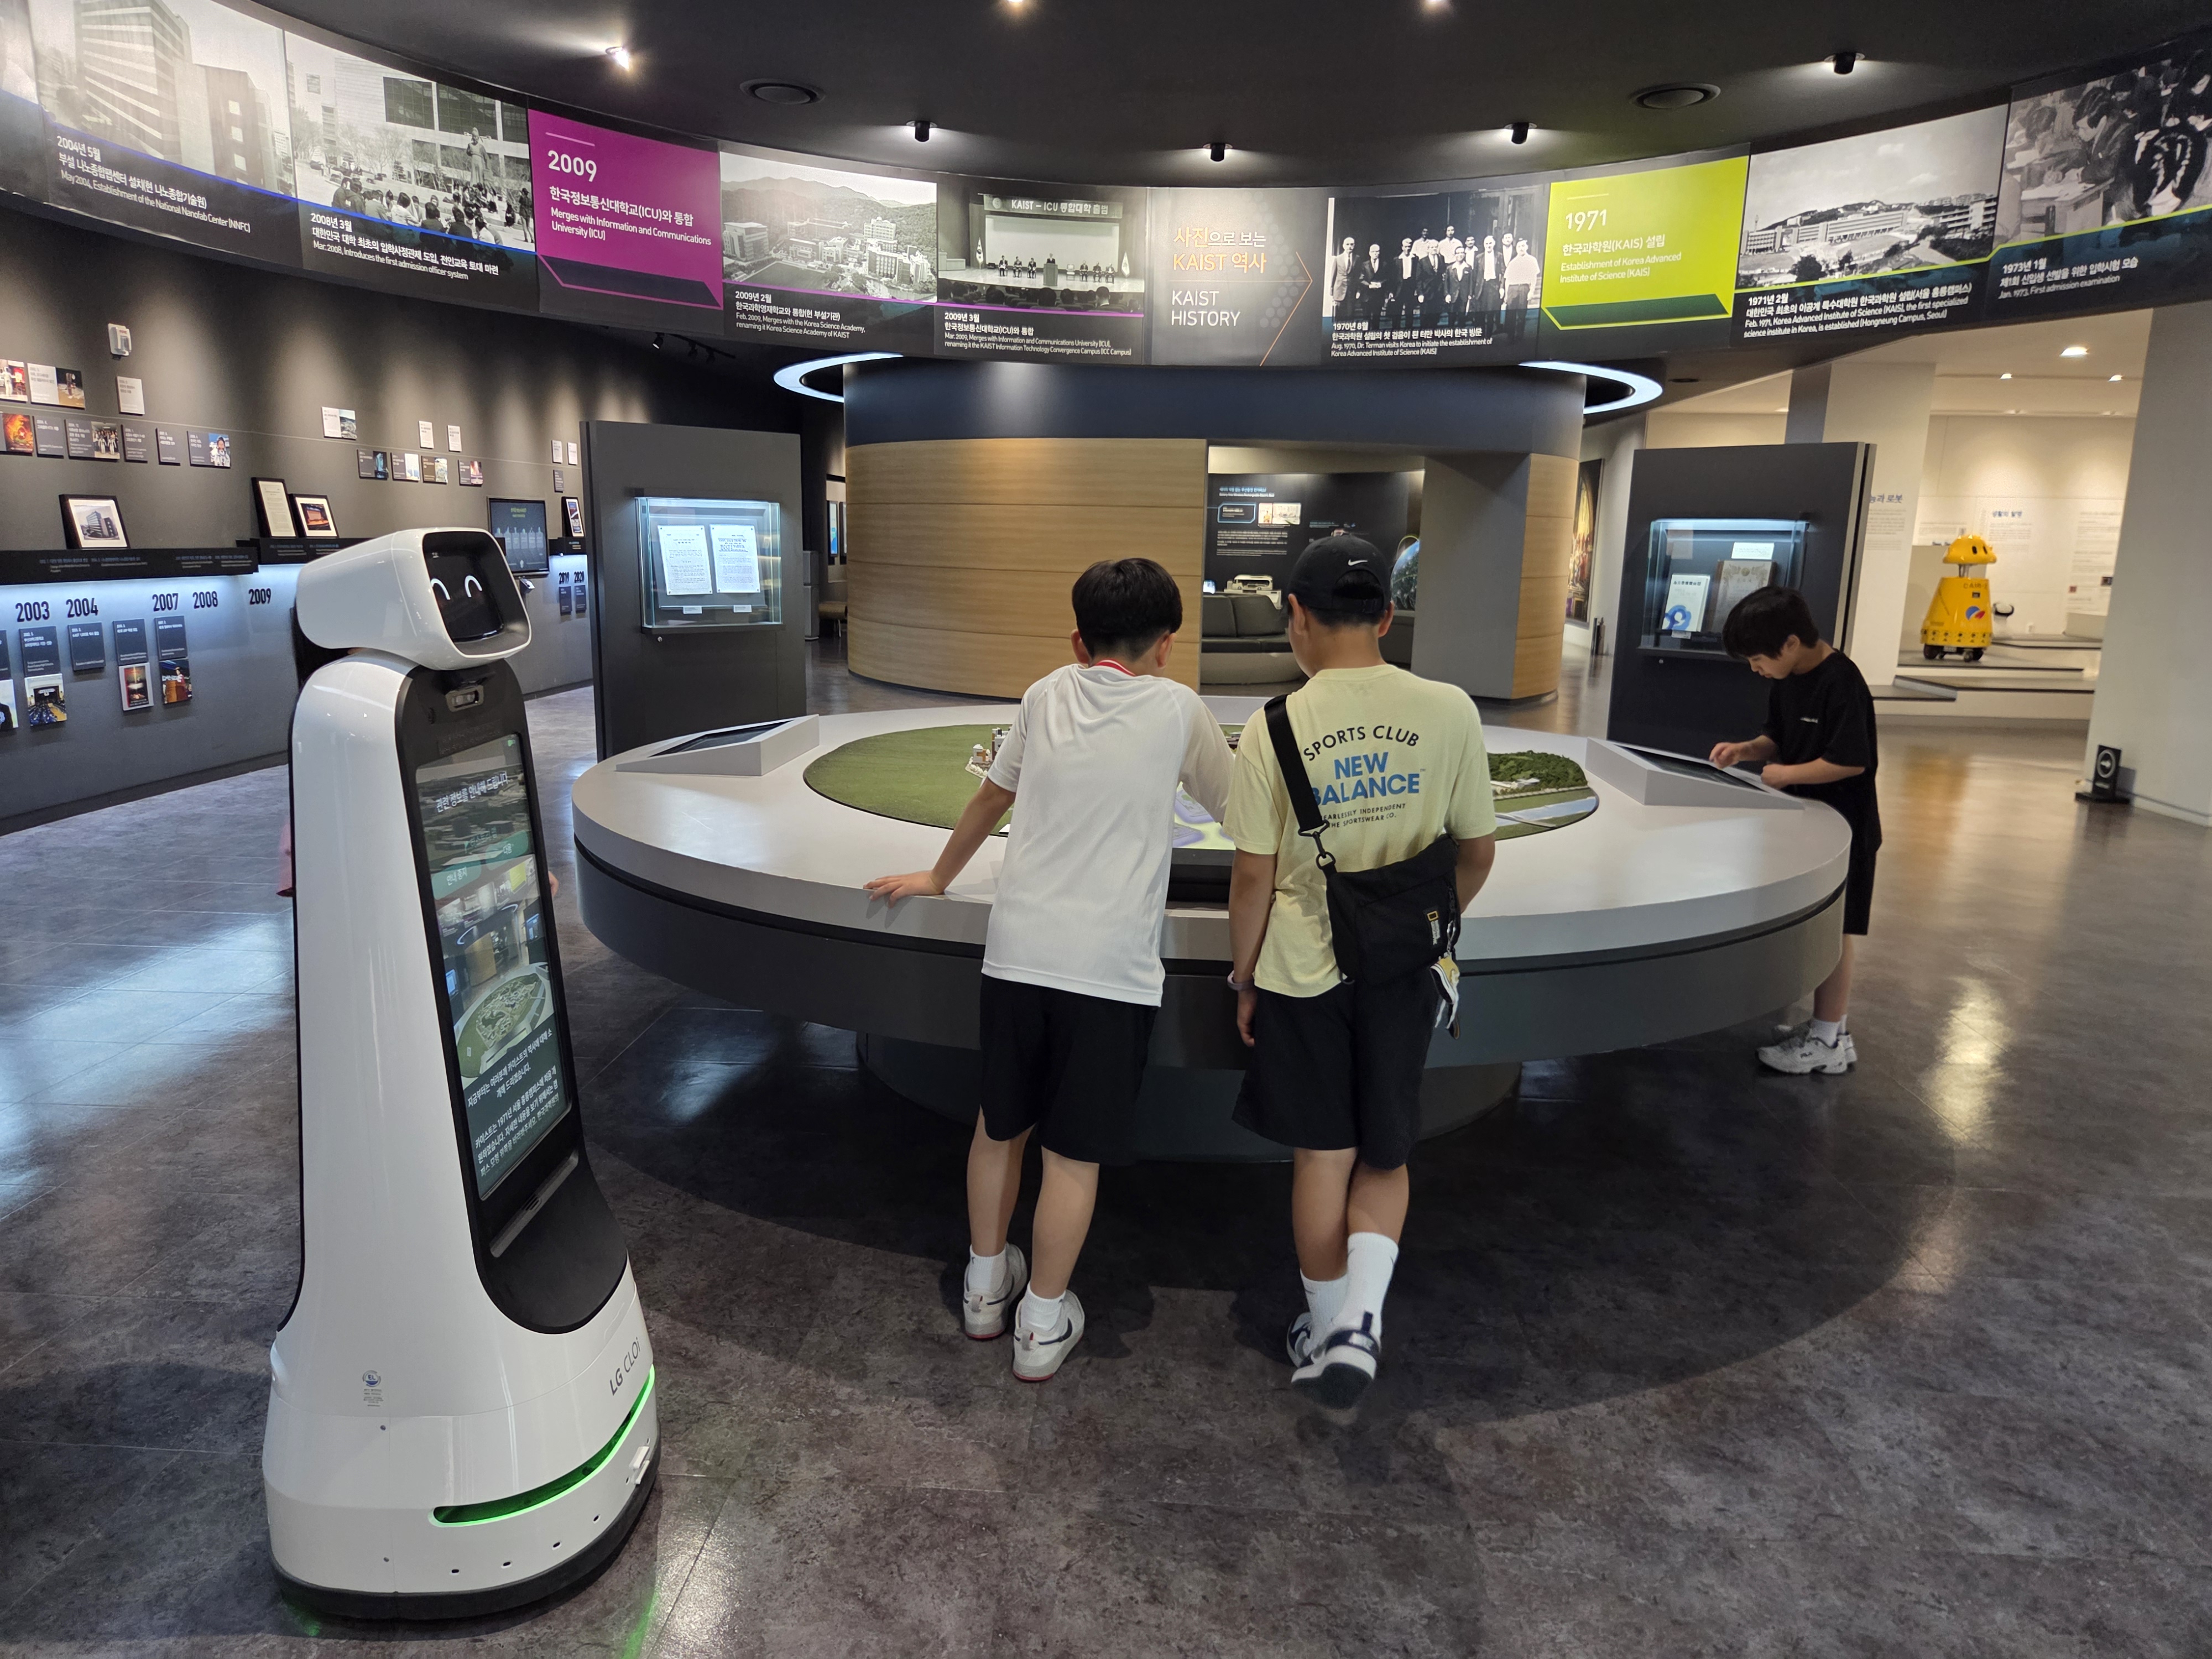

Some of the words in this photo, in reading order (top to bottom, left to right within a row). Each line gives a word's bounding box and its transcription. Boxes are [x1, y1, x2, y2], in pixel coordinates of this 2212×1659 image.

[57, 135, 87, 156] 2004년
[87, 146, 101, 162] 5월
[547, 150, 597, 182] 2009
[59, 152, 75, 169] 부설
[76, 159, 127, 186] 나노종합팹센터
[154, 184, 207, 210] 나노종합기술원)
[61, 169, 75, 184] May
[92, 179, 138, 202] Establishment
[138, 194, 144, 203] of
[144, 196, 155, 207] the
[155, 199, 181, 214] National
[181, 206, 207, 221] Nanofab
[208, 213, 228, 226] Center
[228, 218, 251, 233] (NNFC)
[549, 186, 672, 223] 한국정보통신대학교(ICU)와
[674, 211, 693, 227] 통합
[1011, 200, 1034, 210] KAIST
[1044, 201, 1058, 212] ICU
[1060, 203, 1091, 214] 통합대학
[310, 213, 338, 229] 2008년
[338, 220, 353, 232] 3월
[551, 207, 578, 222] Merges
[580, 213, 596, 225] with
[596, 216, 638, 233] Information
[638, 225, 652, 236] and
[653, 227, 712, 246] Communications
[1566, 208, 1607, 232] 1971
[551, 221, 588, 238] University
[589, 228, 606, 241] (ICU)
[1173, 226, 1235, 248] 사진으로
[1238, 231, 1266, 247] 보는
[312, 227, 340, 243] 대한민국
[342, 234, 356, 246] 대학
[358, 237, 379, 252] 최초의
[380, 242, 422, 261] 입학사정관제
[423, 252, 439, 264] 도입,
[440, 254, 468, 270] 전인교육
[469, 261, 483, 272] 토대
[484, 264, 499, 275] 마련
[1562, 237, 1643, 257] 한국과학원(KAIS)
[1646, 234, 1665, 249] 설립
[313, 239, 325, 250] Mar.
[327, 244, 343, 255] 2008,
[344, 247, 375, 262] Introduces
[375, 254, 385, 264] the
[385, 256, 398, 266] first
[398, 260, 428, 273] admission
[428, 265, 447, 275] officer
[447, 270, 469, 280] system
[1173, 253, 1227, 271] KAIST
[1231, 252, 1267, 273] 역사
[1561, 257, 1613, 272] Establishment
[1614, 257, 1621, 267] of
[1621, 255, 1644, 266] Korea
[1645, 252, 1682, 264] Advanced
[2002, 259, 2032, 274] 1973년
[2033, 257, 2047, 270] 1월
[1559, 271, 1589, 284] Institute
[1589, 271, 1597, 281] of
[1598, 269, 1626, 280] Science
[1627, 267, 1650, 279] (KAIS)
[735, 291, 759, 302] 2009년
[760, 294, 771, 304] 2월
[1172, 290, 1219, 306] KAIST
[1748, 294, 1774, 306] 1971년
[1775, 292, 1788, 304] 2월
[735, 301, 791, 316] 한국과학영재학교와
[814, 310, 841, 321] 부설기관)
[944, 312, 968, 322] 2009년
[969, 314, 980, 323] 3월
[1171, 310, 1241, 326] HISTORY
[736, 322, 761, 331] renaming
[766, 324, 782, 332] Korea
[782, 326, 802, 335] Science
[803, 328, 827, 338] Academy
[833, 331, 851, 339] KAIST
[748, 314, 762, 322] 2009,
[763, 315, 782, 325] Merges
[804, 320, 820, 328] Korea
[820, 321, 840, 330] Science
[840, 323, 865, 333] Academy,
[1021, 327, 1034, 336] 통합
[1333, 322, 1356, 331] 1970년
[1357, 321, 1369, 331] 8월
[1332, 332, 1363, 341] 한국과학원
[15, 601, 50, 622] 2003
[66, 598, 98, 618] 2004
[152, 593, 179, 612] 2007
[192, 591, 218, 609] 2008
[248, 588, 272, 605] 2009
[1303, 726, 1366, 761] SPORTS
[1373, 725, 1419, 747] CLUB
[1334, 752, 1389, 780] NEW
[436, 795, 451, 813] 관련
[450, 788, 468, 807] 정보를
[468, 780, 487, 799] 안내해
[1360, 804, 1406, 814] INDEPENDENT
[1343, 815, 1384, 827] SPORTSWEAR
[503, 843, 513, 855] 다음
[446, 873, 457, 886] 안내
[457, 866, 468, 880] 중지
[468, 1083, 491, 1108] 지금부터는
[508, 1048, 528, 1073] 카이스트의
[497, 1108, 513, 1128] 1971년
[609, 1368, 623, 1396] LG
[624, 1337, 640, 1373] CLOi
